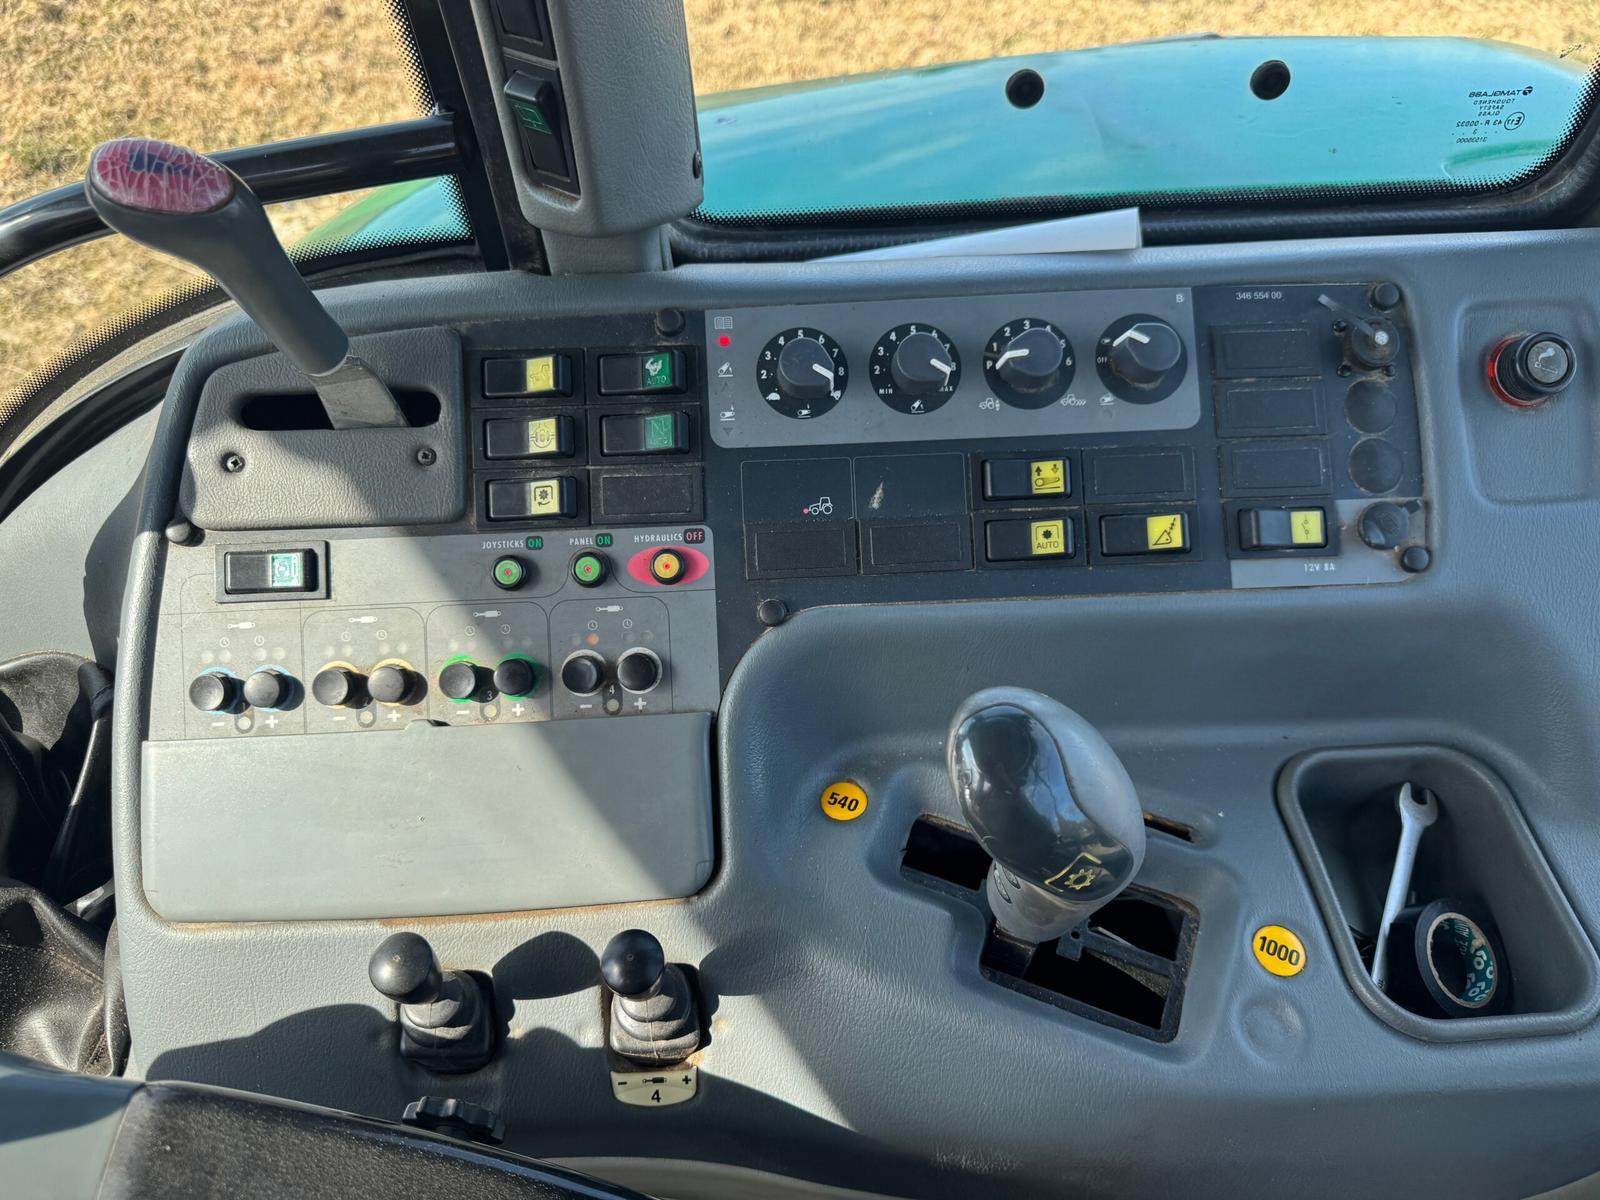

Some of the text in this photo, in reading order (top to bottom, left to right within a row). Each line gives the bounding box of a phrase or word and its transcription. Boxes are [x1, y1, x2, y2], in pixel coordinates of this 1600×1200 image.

[1176, 294, 1184, 303] B
[1024, 320, 1030, 330] 3
[798, 330, 804, 338] 5
[910, 326, 916, 334] 5
[1004, 327, 1010, 337] 2
[778, 336, 785, 346] 4
[819, 335, 824, 344] 6
[890, 332, 896, 342] 4
[878, 347, 884, 356] 3
[992, 343, 997, 351] 1
[765, 352, 771, 360] 3
[833, 349, 838, 357] 7
[987, 361, 993, 370] P
[1066, 356, 1072, 366] 6
[761, 370, 767, 379] 2
[839, 367, 845, 376] 8
[874, 366, 880, 374] 2
[569, 535, 611, 546] PANEL ON
[634, 531, 703, 543] HYDRAULICS OFF
[482, 537, 542, 549] JOYSTICKS ON
[1036, 541, 1059, 550] AUTO
[1304, 564, 1320, 572] 12V
[609, 685, 615, 695] 4
[487, 690, 493, 700] 3
[828, 792, 859, 812] 540
[1260, 936, 1300, 966] 1000
[651, 1089, 661, 1103] 4
